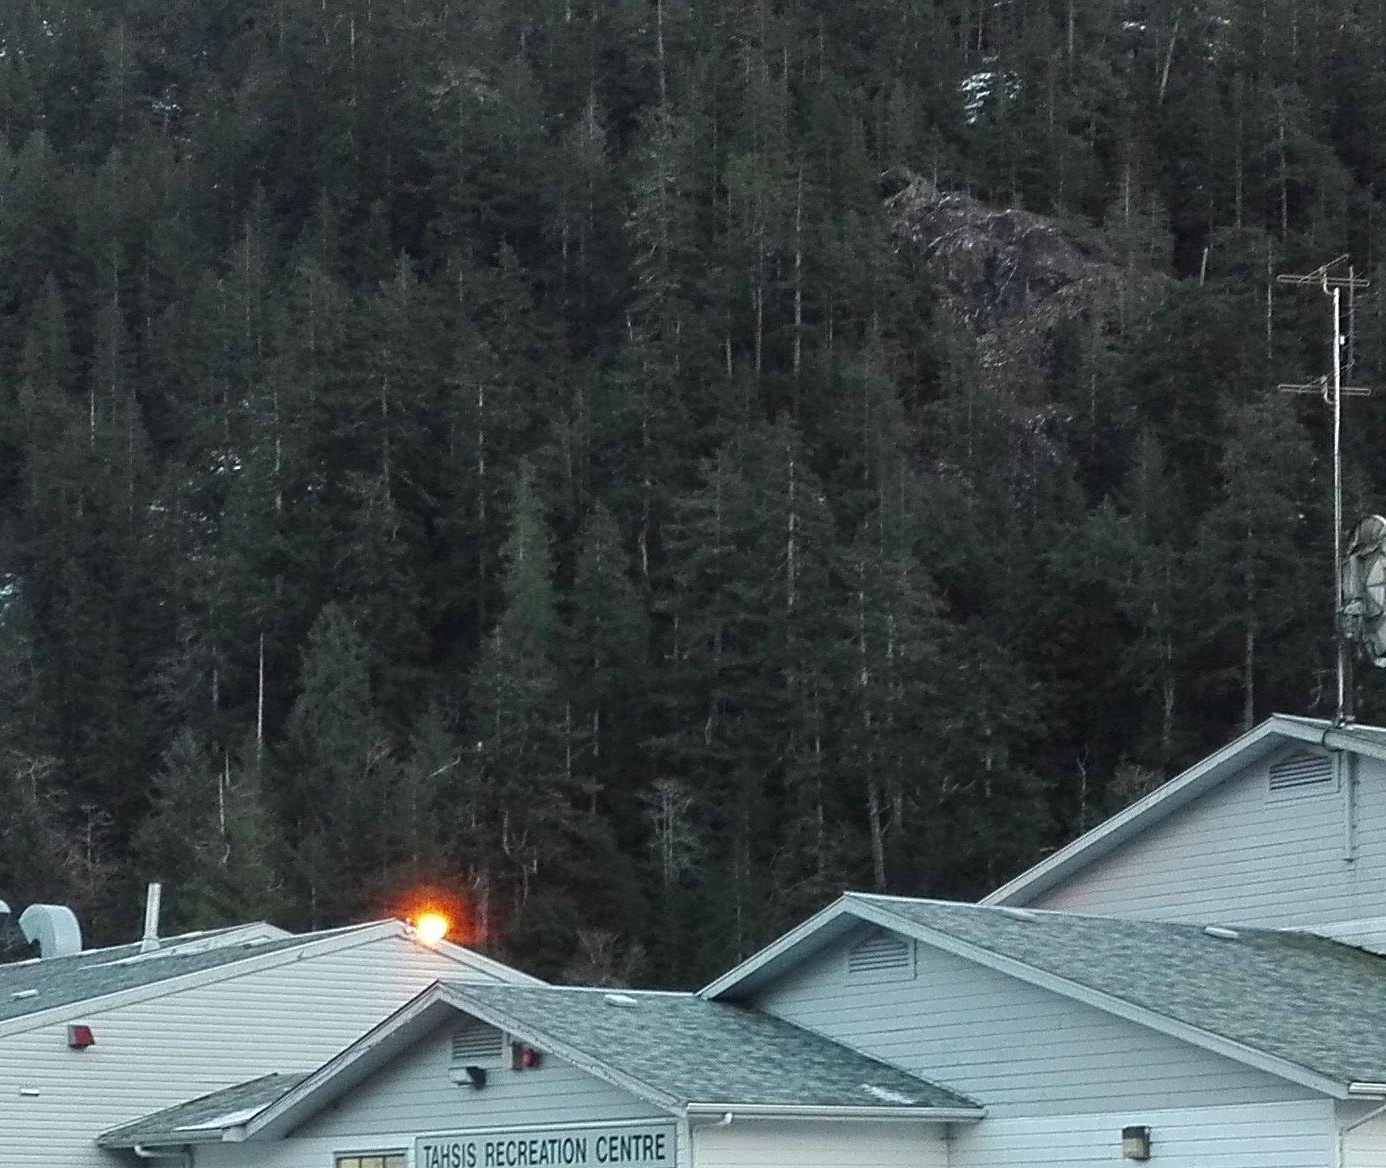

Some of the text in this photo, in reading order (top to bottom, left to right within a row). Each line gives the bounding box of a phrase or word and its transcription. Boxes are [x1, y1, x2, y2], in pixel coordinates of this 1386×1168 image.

[423, 1133, 666, 1168] TAHSIS RECREATION CENTRE
